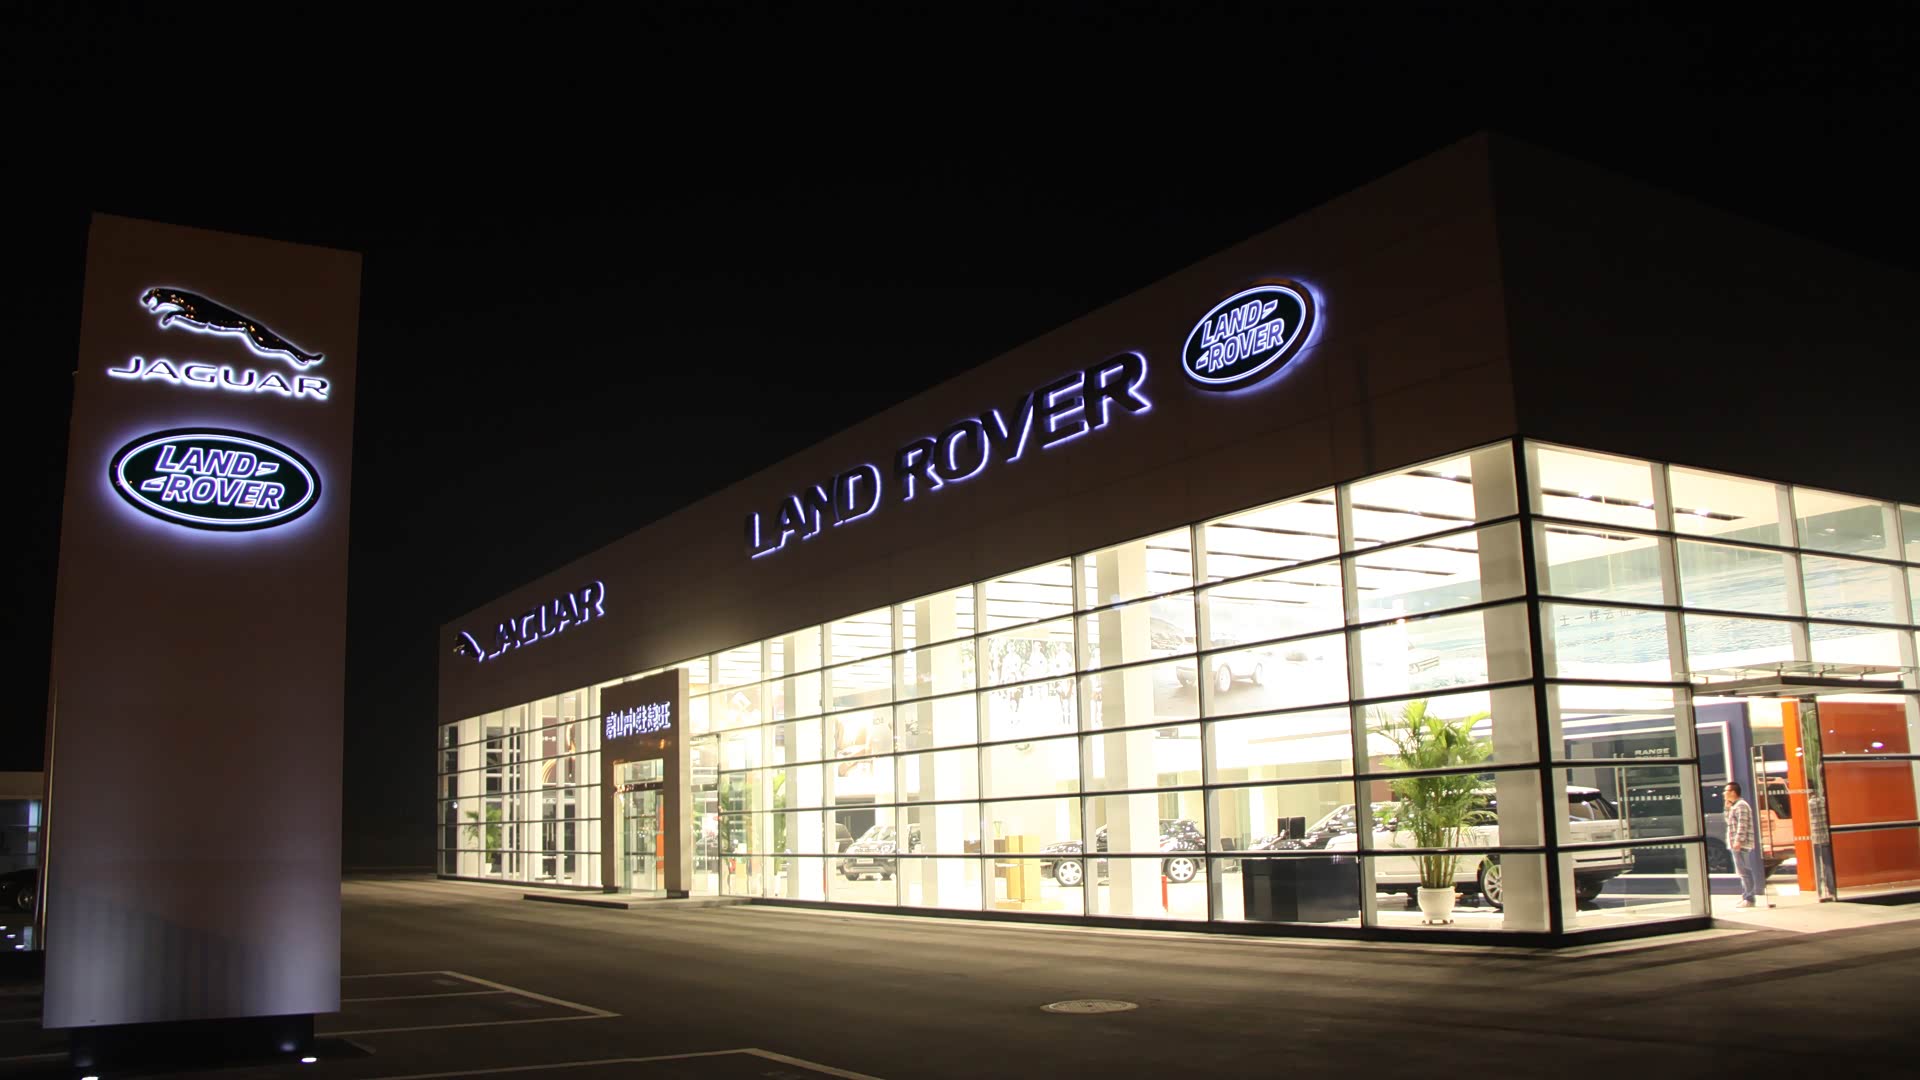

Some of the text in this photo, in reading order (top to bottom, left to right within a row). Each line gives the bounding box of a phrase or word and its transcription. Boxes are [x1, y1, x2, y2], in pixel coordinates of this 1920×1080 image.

[107, 357, 330, 400] JAGUAR
[744, 350, 1152, 559] LAND ROVER
[1634, 747, 1671, 756] RANGE
